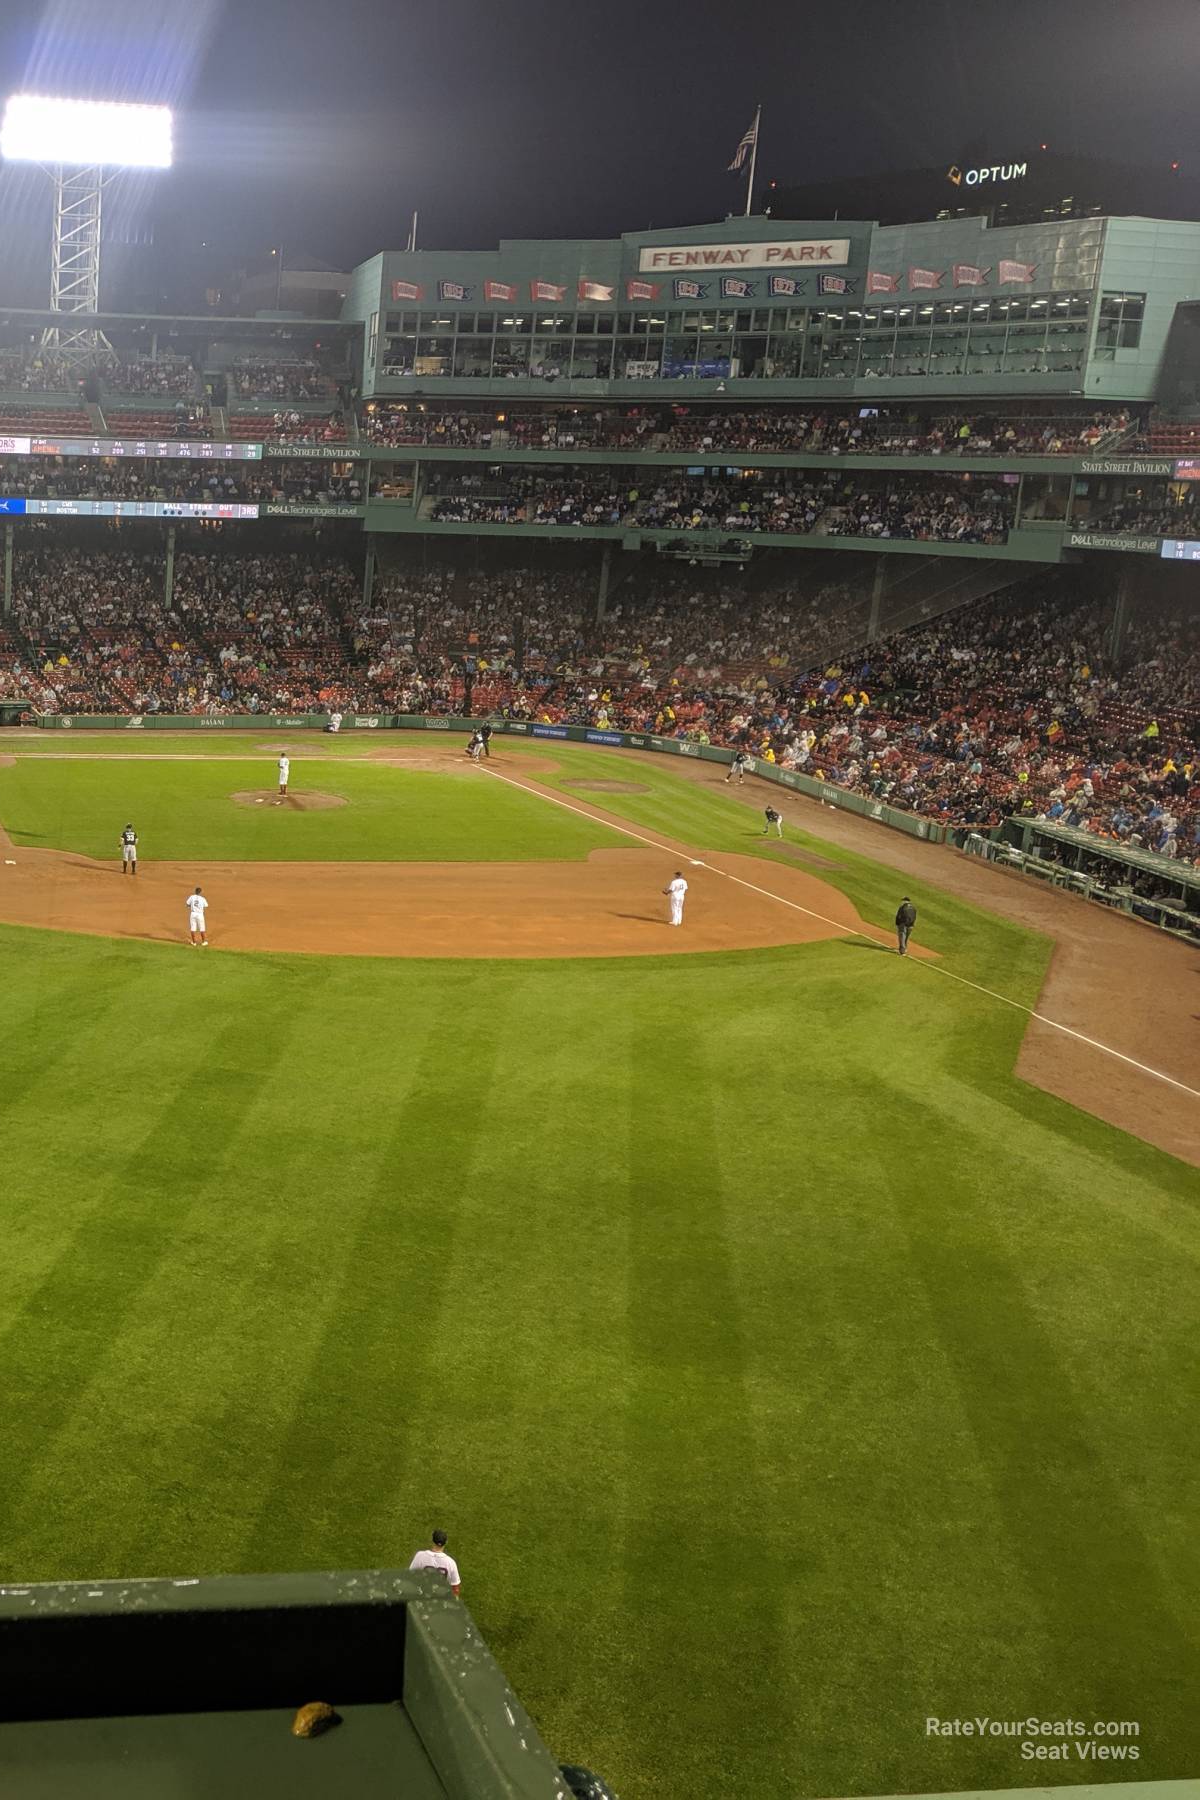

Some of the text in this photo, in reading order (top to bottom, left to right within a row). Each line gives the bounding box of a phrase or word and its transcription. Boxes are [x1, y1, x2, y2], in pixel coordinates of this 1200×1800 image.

[966, 162, 1027, 185] OPTUM
[652, 246, 832, 267] FENWAY PARK
[268, 446, 360, 457] STATE STREET PAVILION
[1082, 461, 1102, 472] STATE
[1104, 462, 1130, 472] STREET
[1133, 463, 1171, 473] PAVILION
[242, 507, 257, 515] 3RD
[289, 506, 337, 516] Technologies
[338, 507, 357, 515] Level
[1071, 535, 1157, 550] DELL Technologies Level
